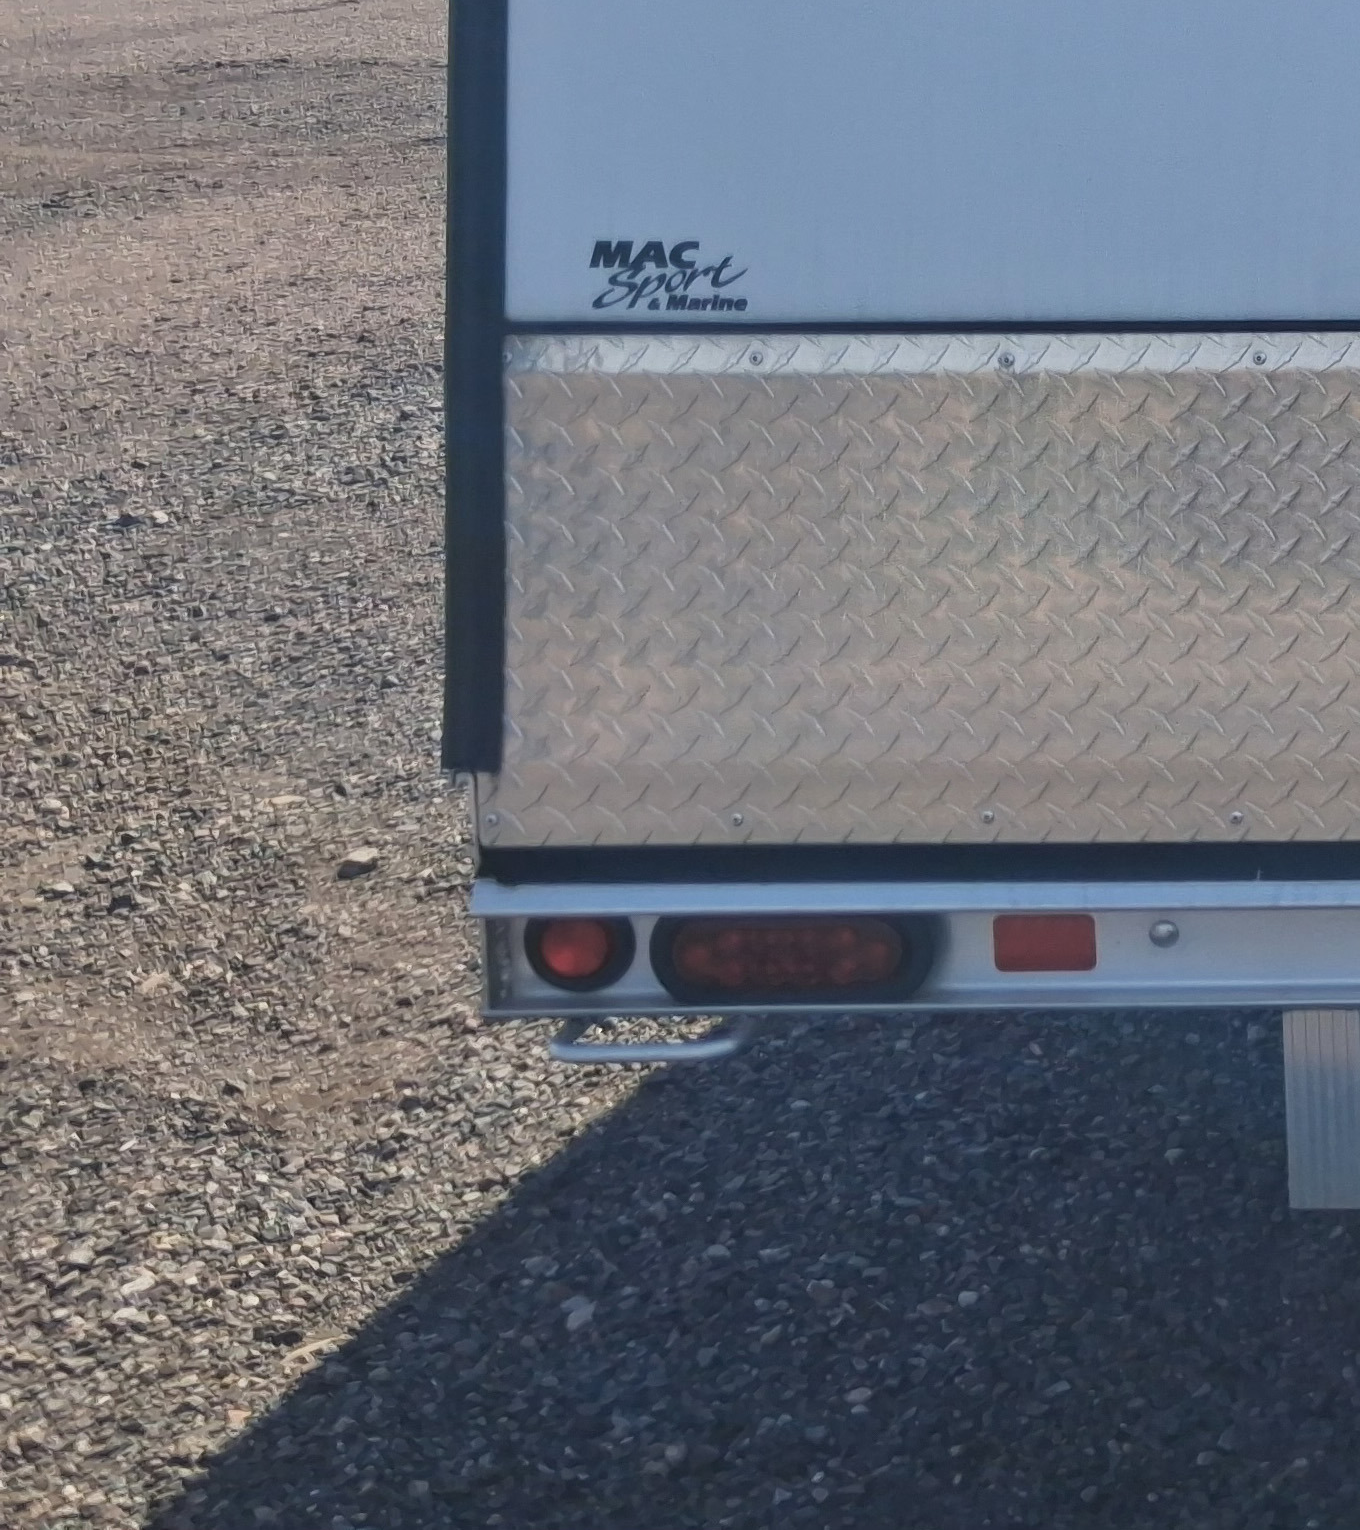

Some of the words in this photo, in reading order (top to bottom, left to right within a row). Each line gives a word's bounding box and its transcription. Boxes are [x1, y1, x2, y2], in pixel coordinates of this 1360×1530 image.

[589, 240, 700, 269] MAC
[592, 255, 748, 310] Sport
[665, 294, 749, 311] Marine
